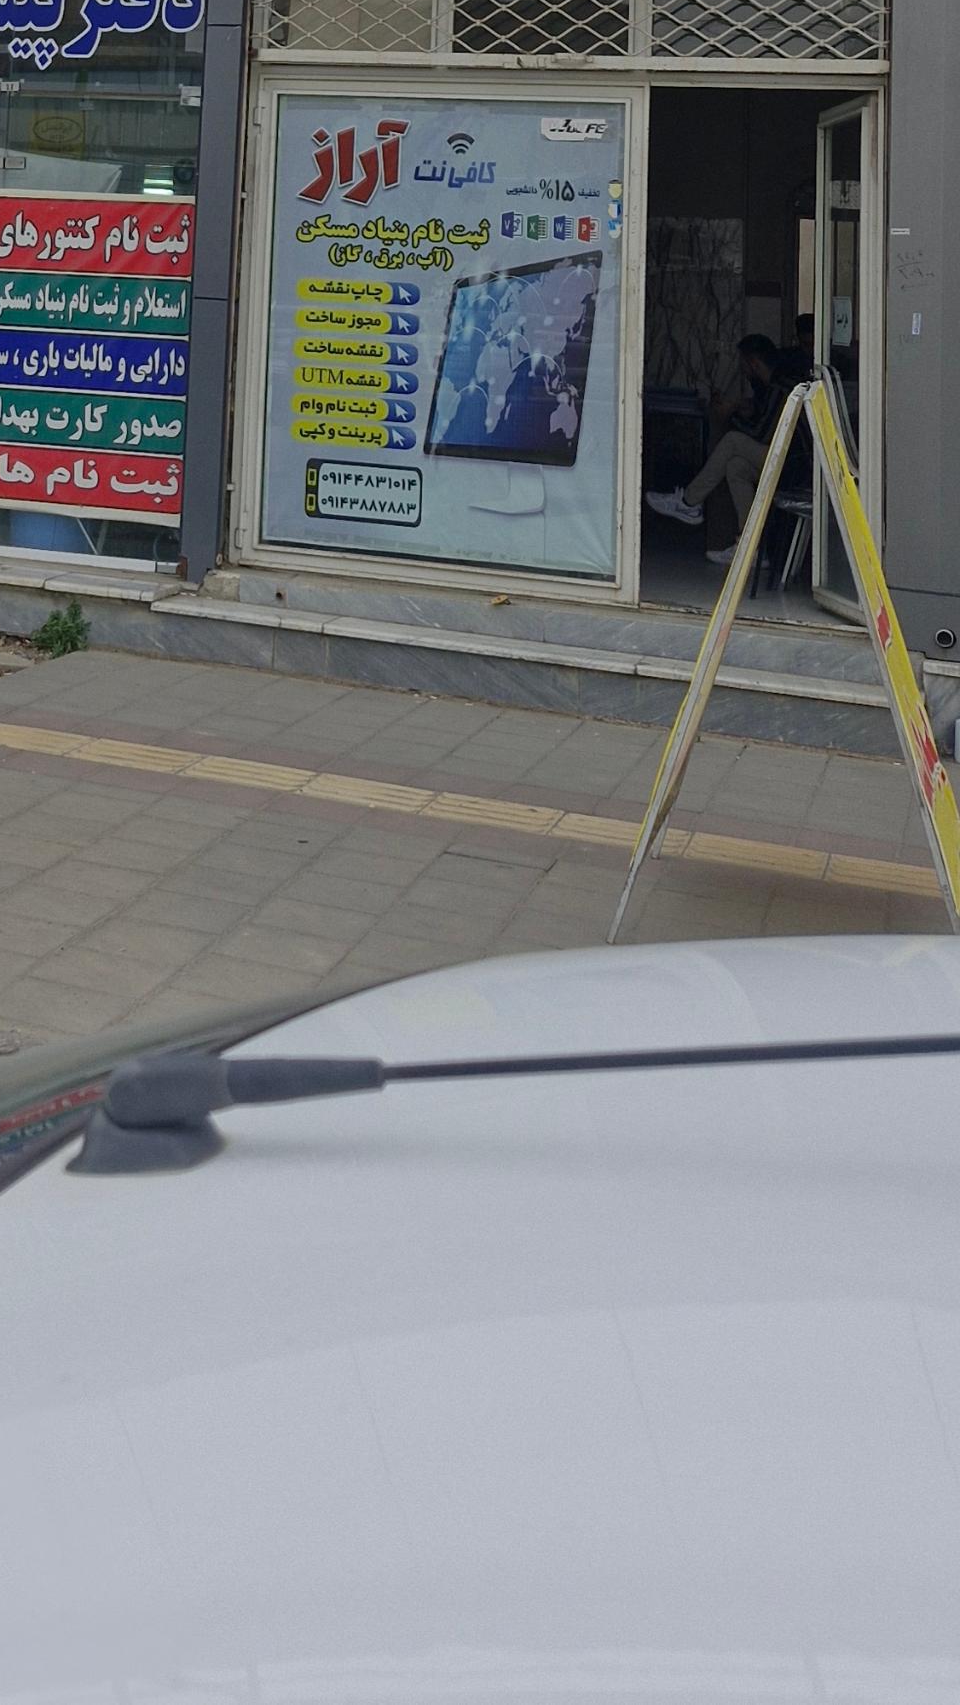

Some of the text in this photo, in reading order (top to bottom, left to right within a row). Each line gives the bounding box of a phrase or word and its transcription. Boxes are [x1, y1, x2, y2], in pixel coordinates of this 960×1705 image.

[296, 118, 411, 207] آراز
[105, 215, 140, 262] نام
[145, 214, 191, 264] ثبت
[296, 214, 490, 250] ثبت نام بنیاد مسکن
[35, 282, 66, 319] بنیاد
[68, 283, 90, 322] نام
[93, 283, 120, 322] ثبت
[133, 286, 187, 326] استعلام
[308, 281, 383, 302] چاپ نقشه
[305, 311, 381, 330] مجوز ساخت
[23, 340, 60, 377] باری
[63, 342, 113, 378] مالیات
[130, 346, 186, 386] دارایی
[303, 341, 384, 358] نقشه ساخت
[115, 356, 127, 382] و
[301, 367, 344, 385] UTM
[45, 402, 108, 441] کارت
[300, 398, 377, 417] ثبت نام وام
[113, 414, 182, 445] صدور
[299, 423, 326, 441] کپی
[338, 425, 382, 445] پرینت
[46, 458, 100, 496] نام
[110, 462, 181, 504] ثبت
